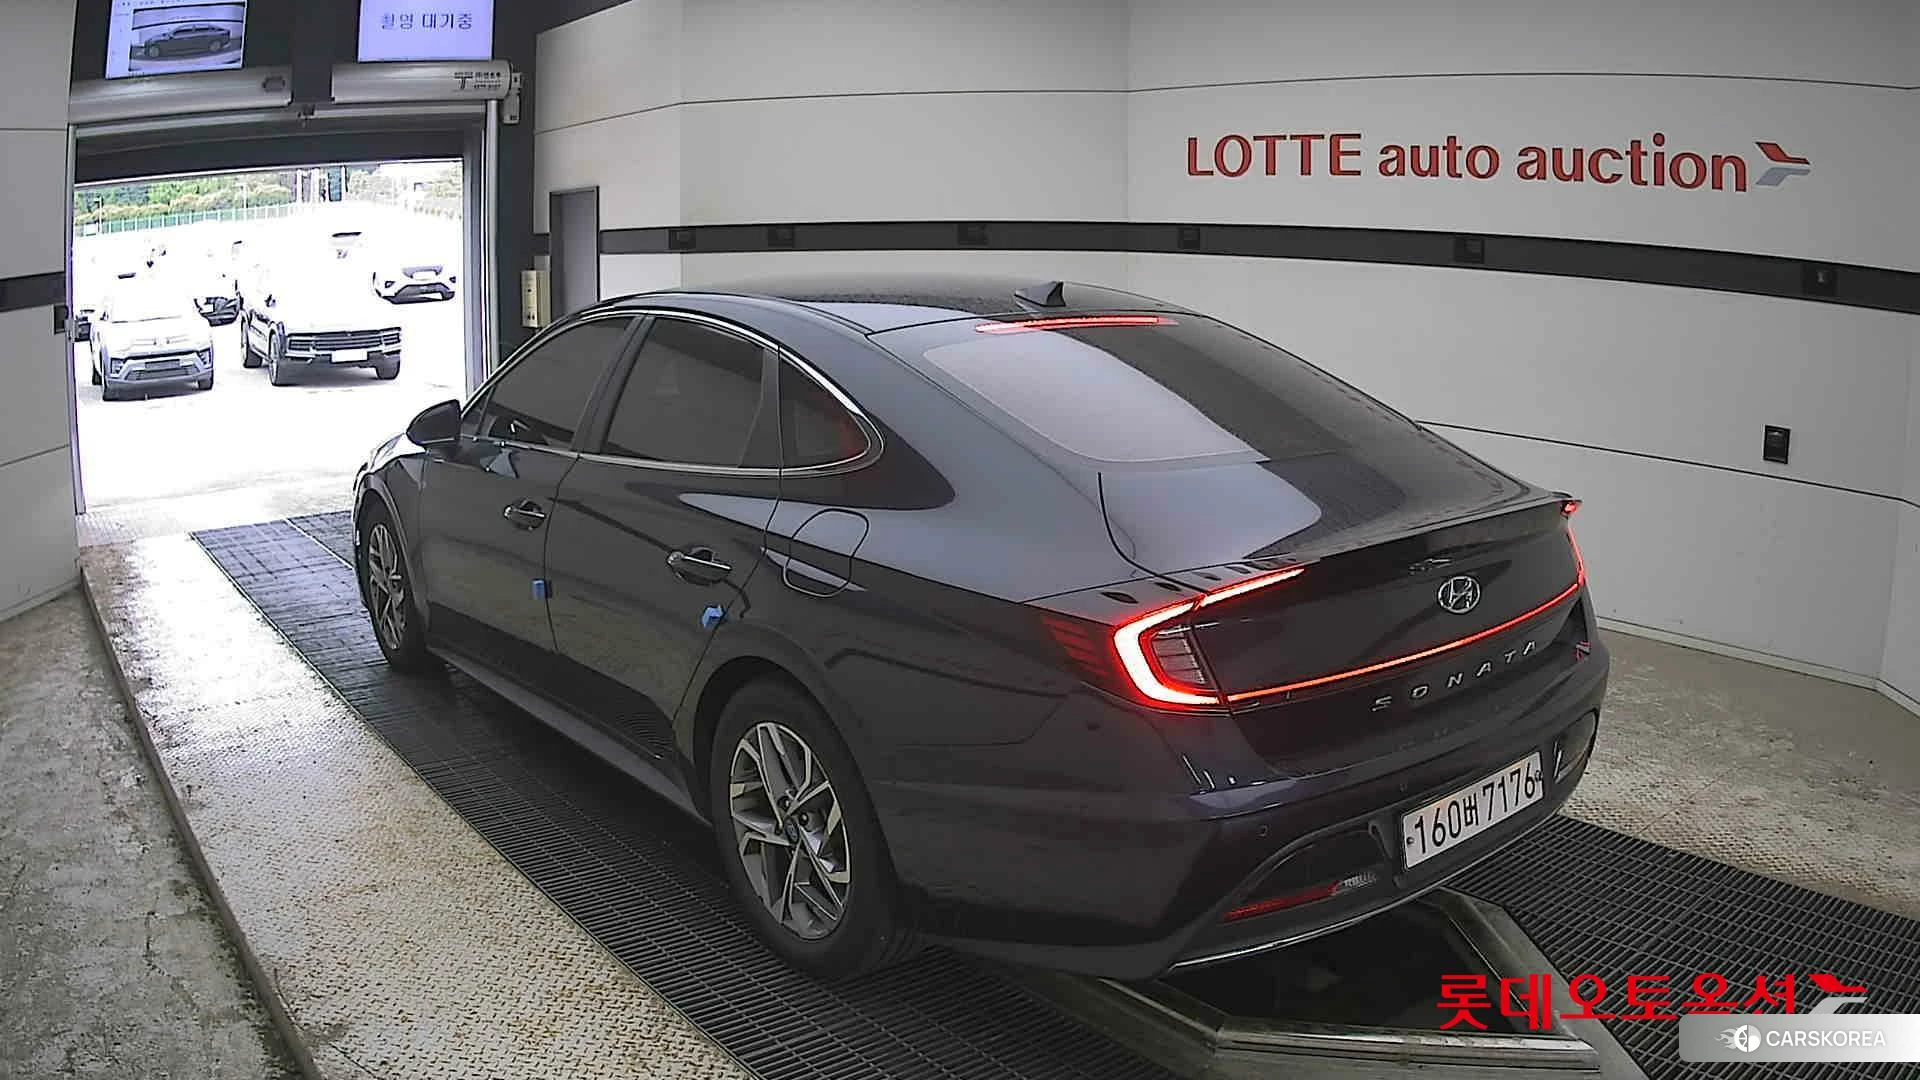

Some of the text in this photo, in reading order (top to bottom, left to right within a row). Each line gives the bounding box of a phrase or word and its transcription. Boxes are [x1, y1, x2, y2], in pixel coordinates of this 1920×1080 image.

[422, 13, 473, 30] 대기중
[1187, 132, 1747, 192] LOTTE auto auction
[1371, 640, 1536, 712] SONATA
